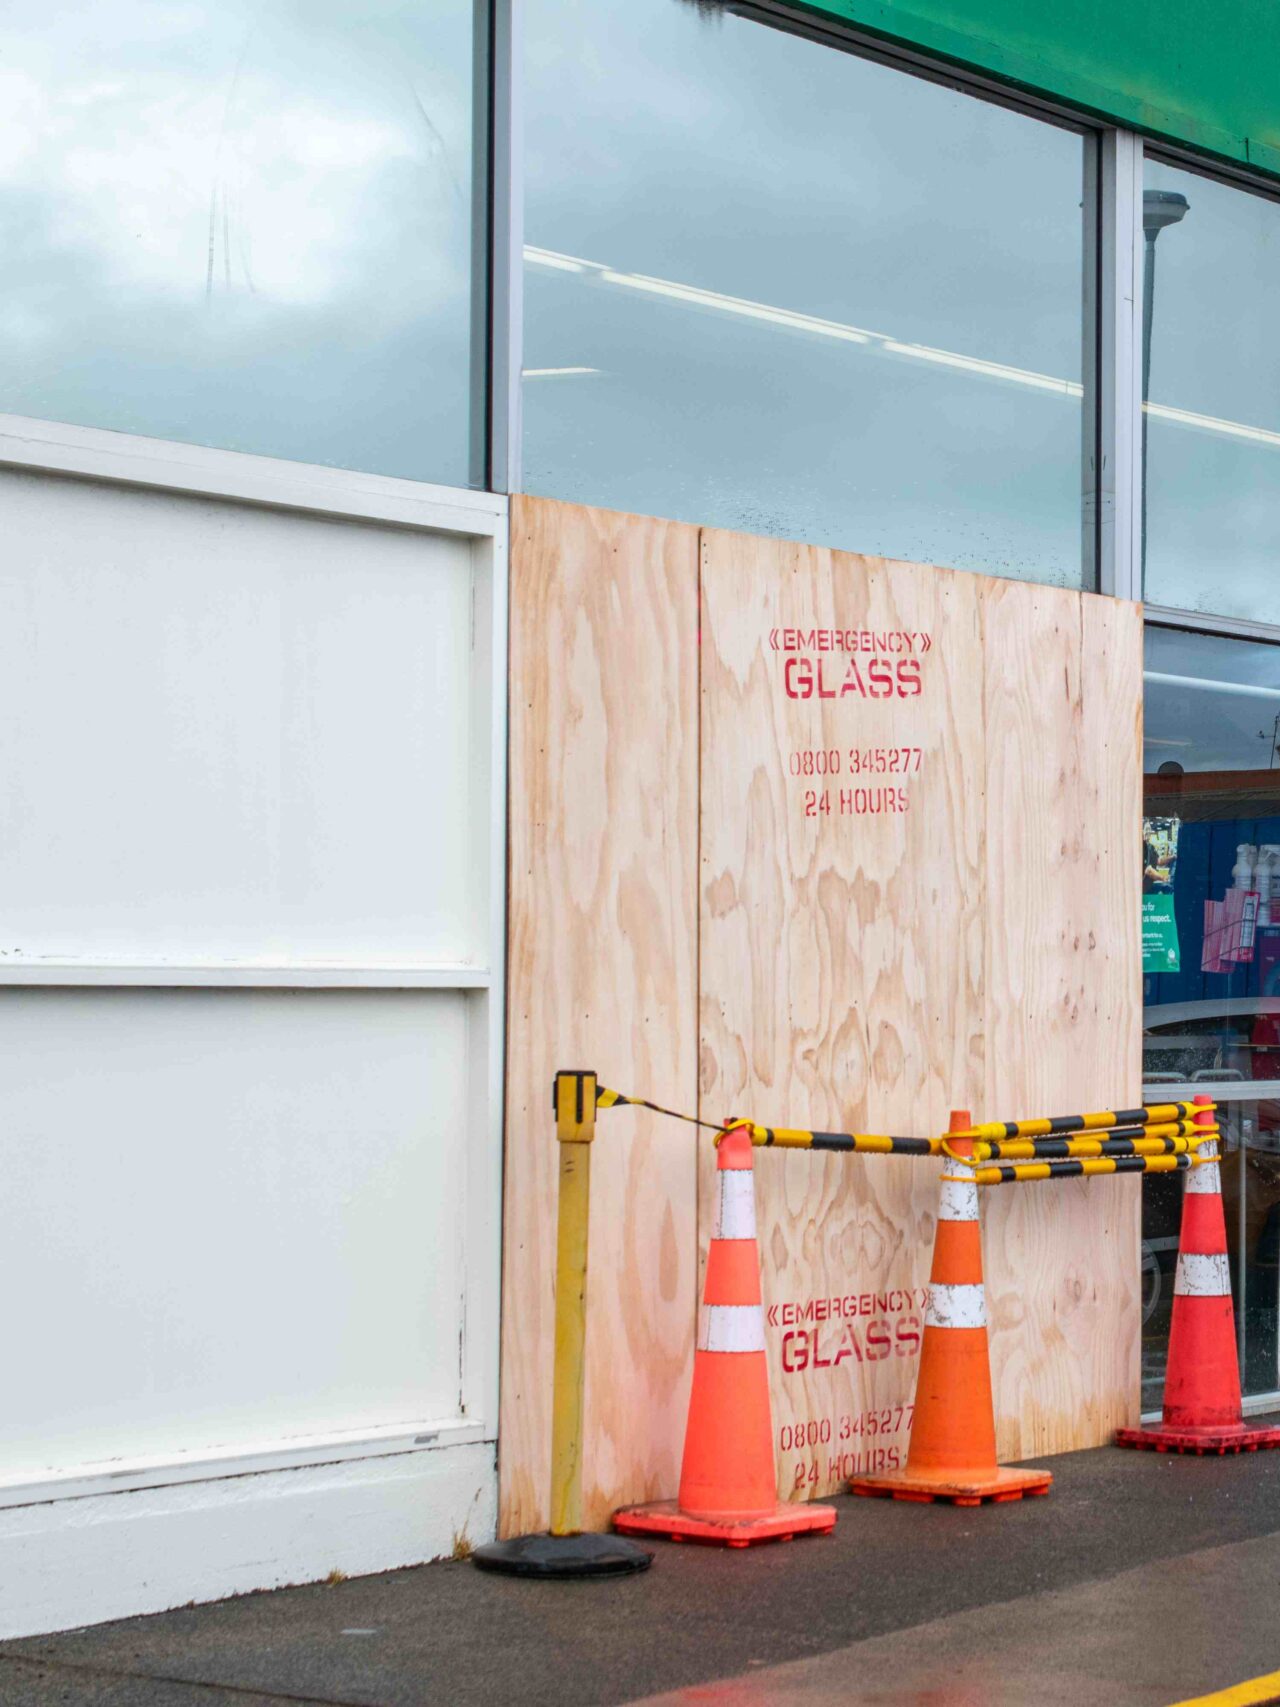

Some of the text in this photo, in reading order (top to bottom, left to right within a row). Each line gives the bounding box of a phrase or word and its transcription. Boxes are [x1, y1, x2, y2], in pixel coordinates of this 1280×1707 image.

[784, 657, 923, 700] GLASS
[789, 747, 923, 777] 0800 345277
[805, 787, 911, 817] 24 HOURS
[781, 1316, 921, 1373] GLASS
[780, 1418, 831, 1452] 0800
[794, 1446, 900, 1489] 24 HOURS
